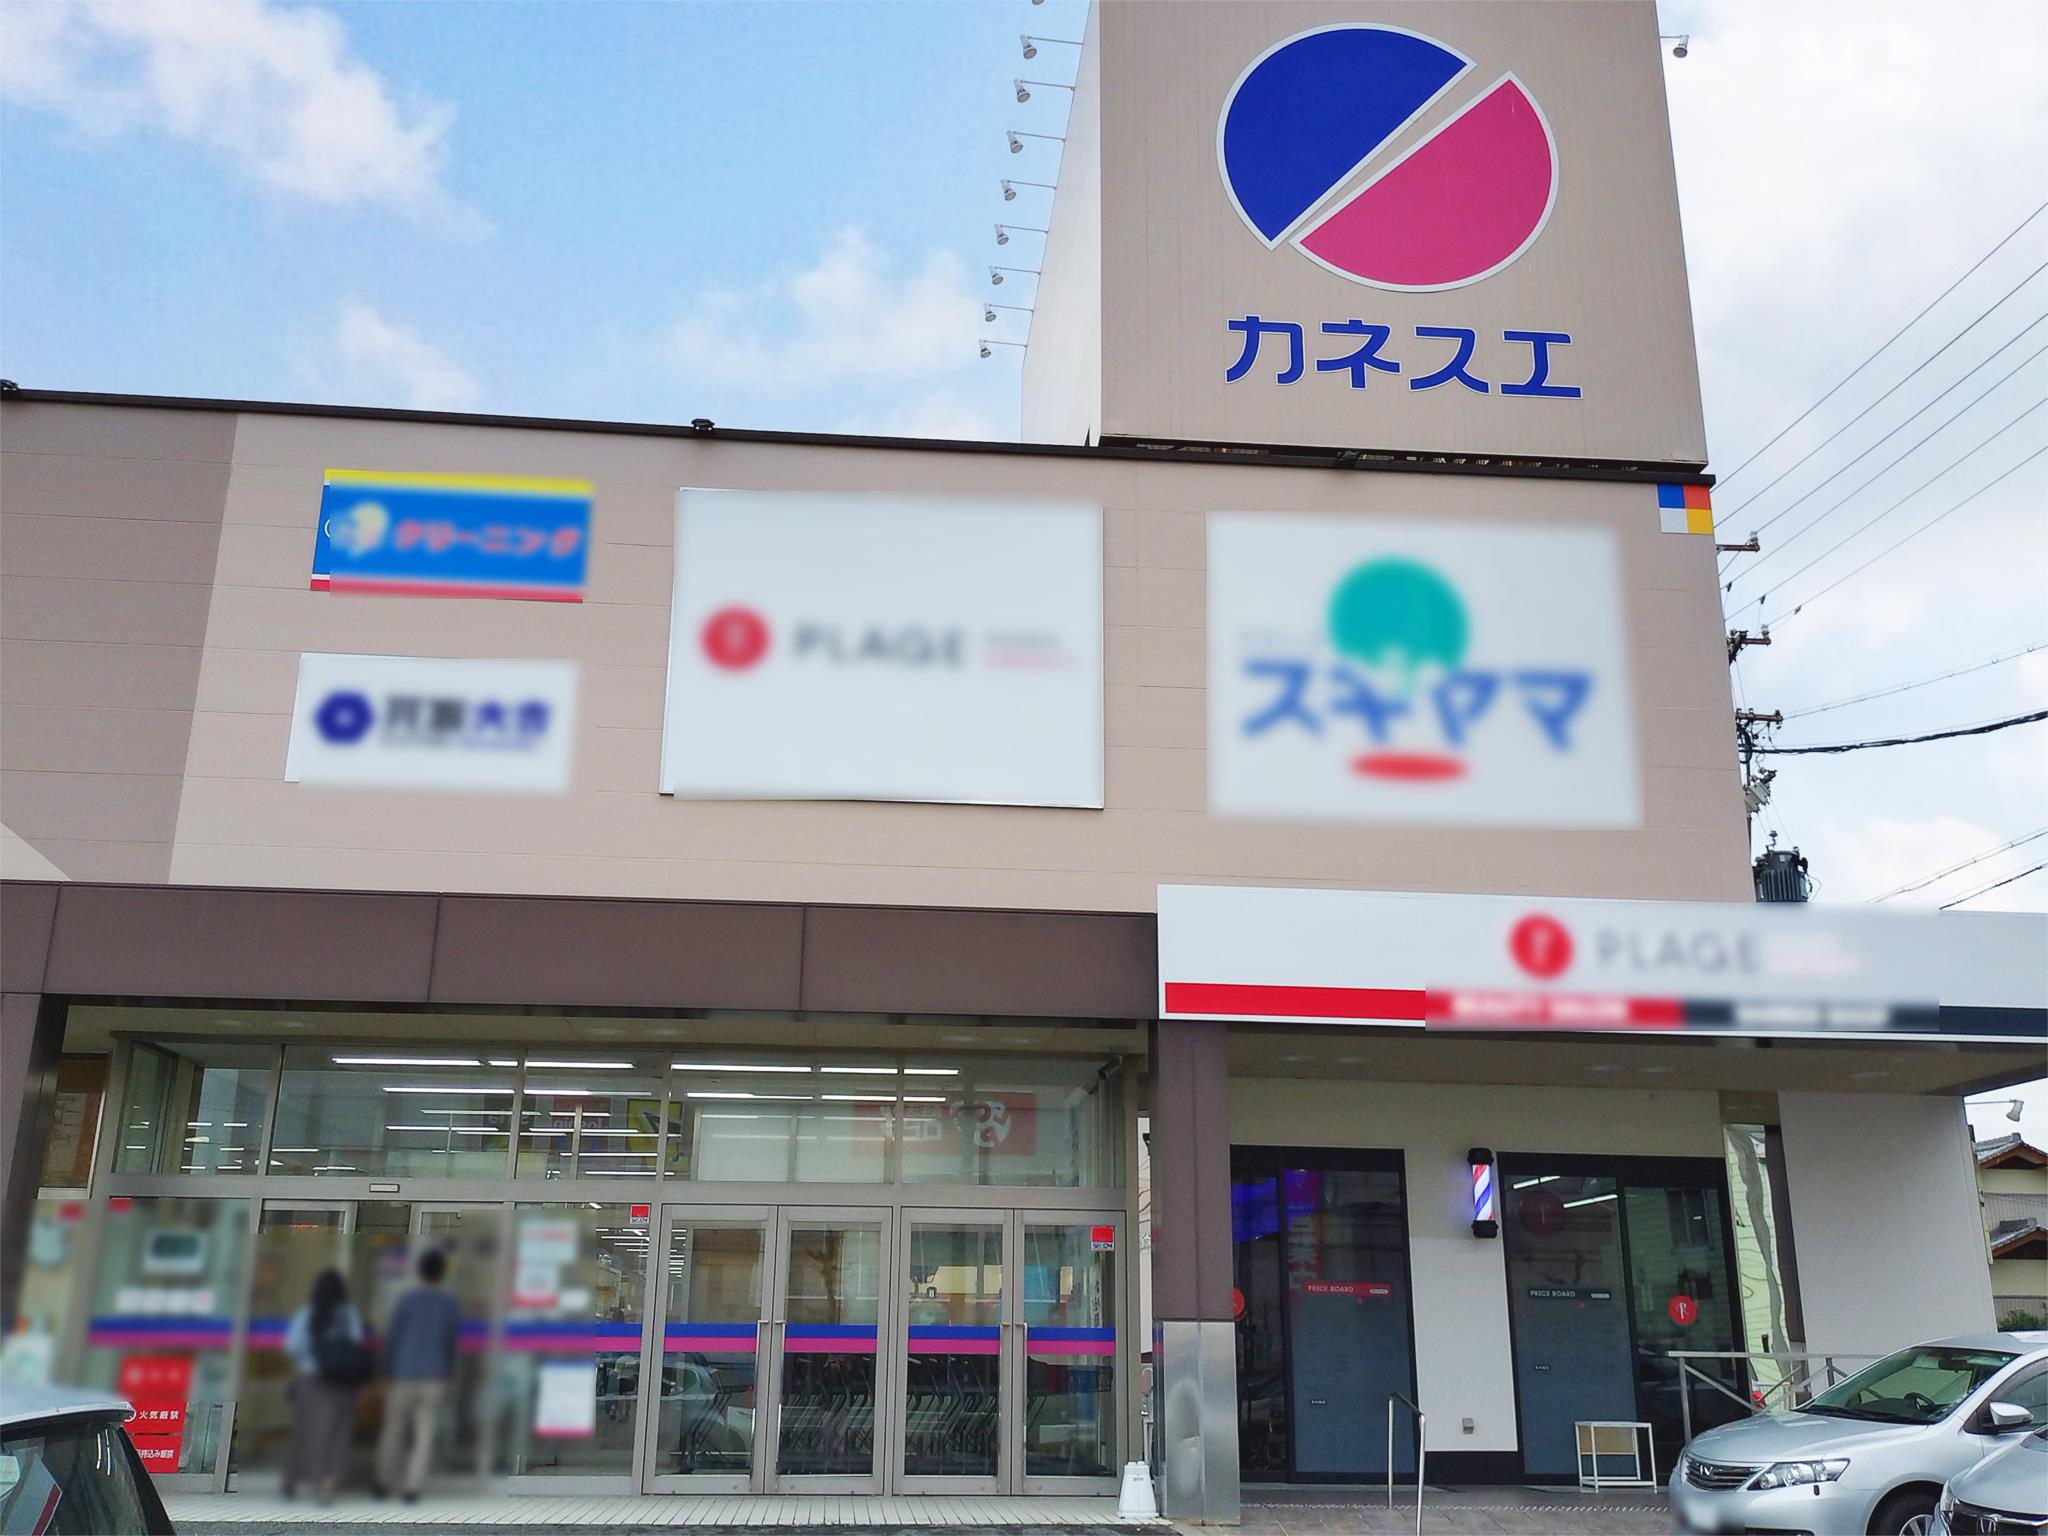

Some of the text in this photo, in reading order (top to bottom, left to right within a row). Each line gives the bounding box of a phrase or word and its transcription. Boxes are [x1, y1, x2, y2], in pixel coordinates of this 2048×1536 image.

[1225, 314, 1582, 400] カネスエ
[792, 622, 968, 669] PLAGE
[1595, 926, 1762, 975] PLAGE
